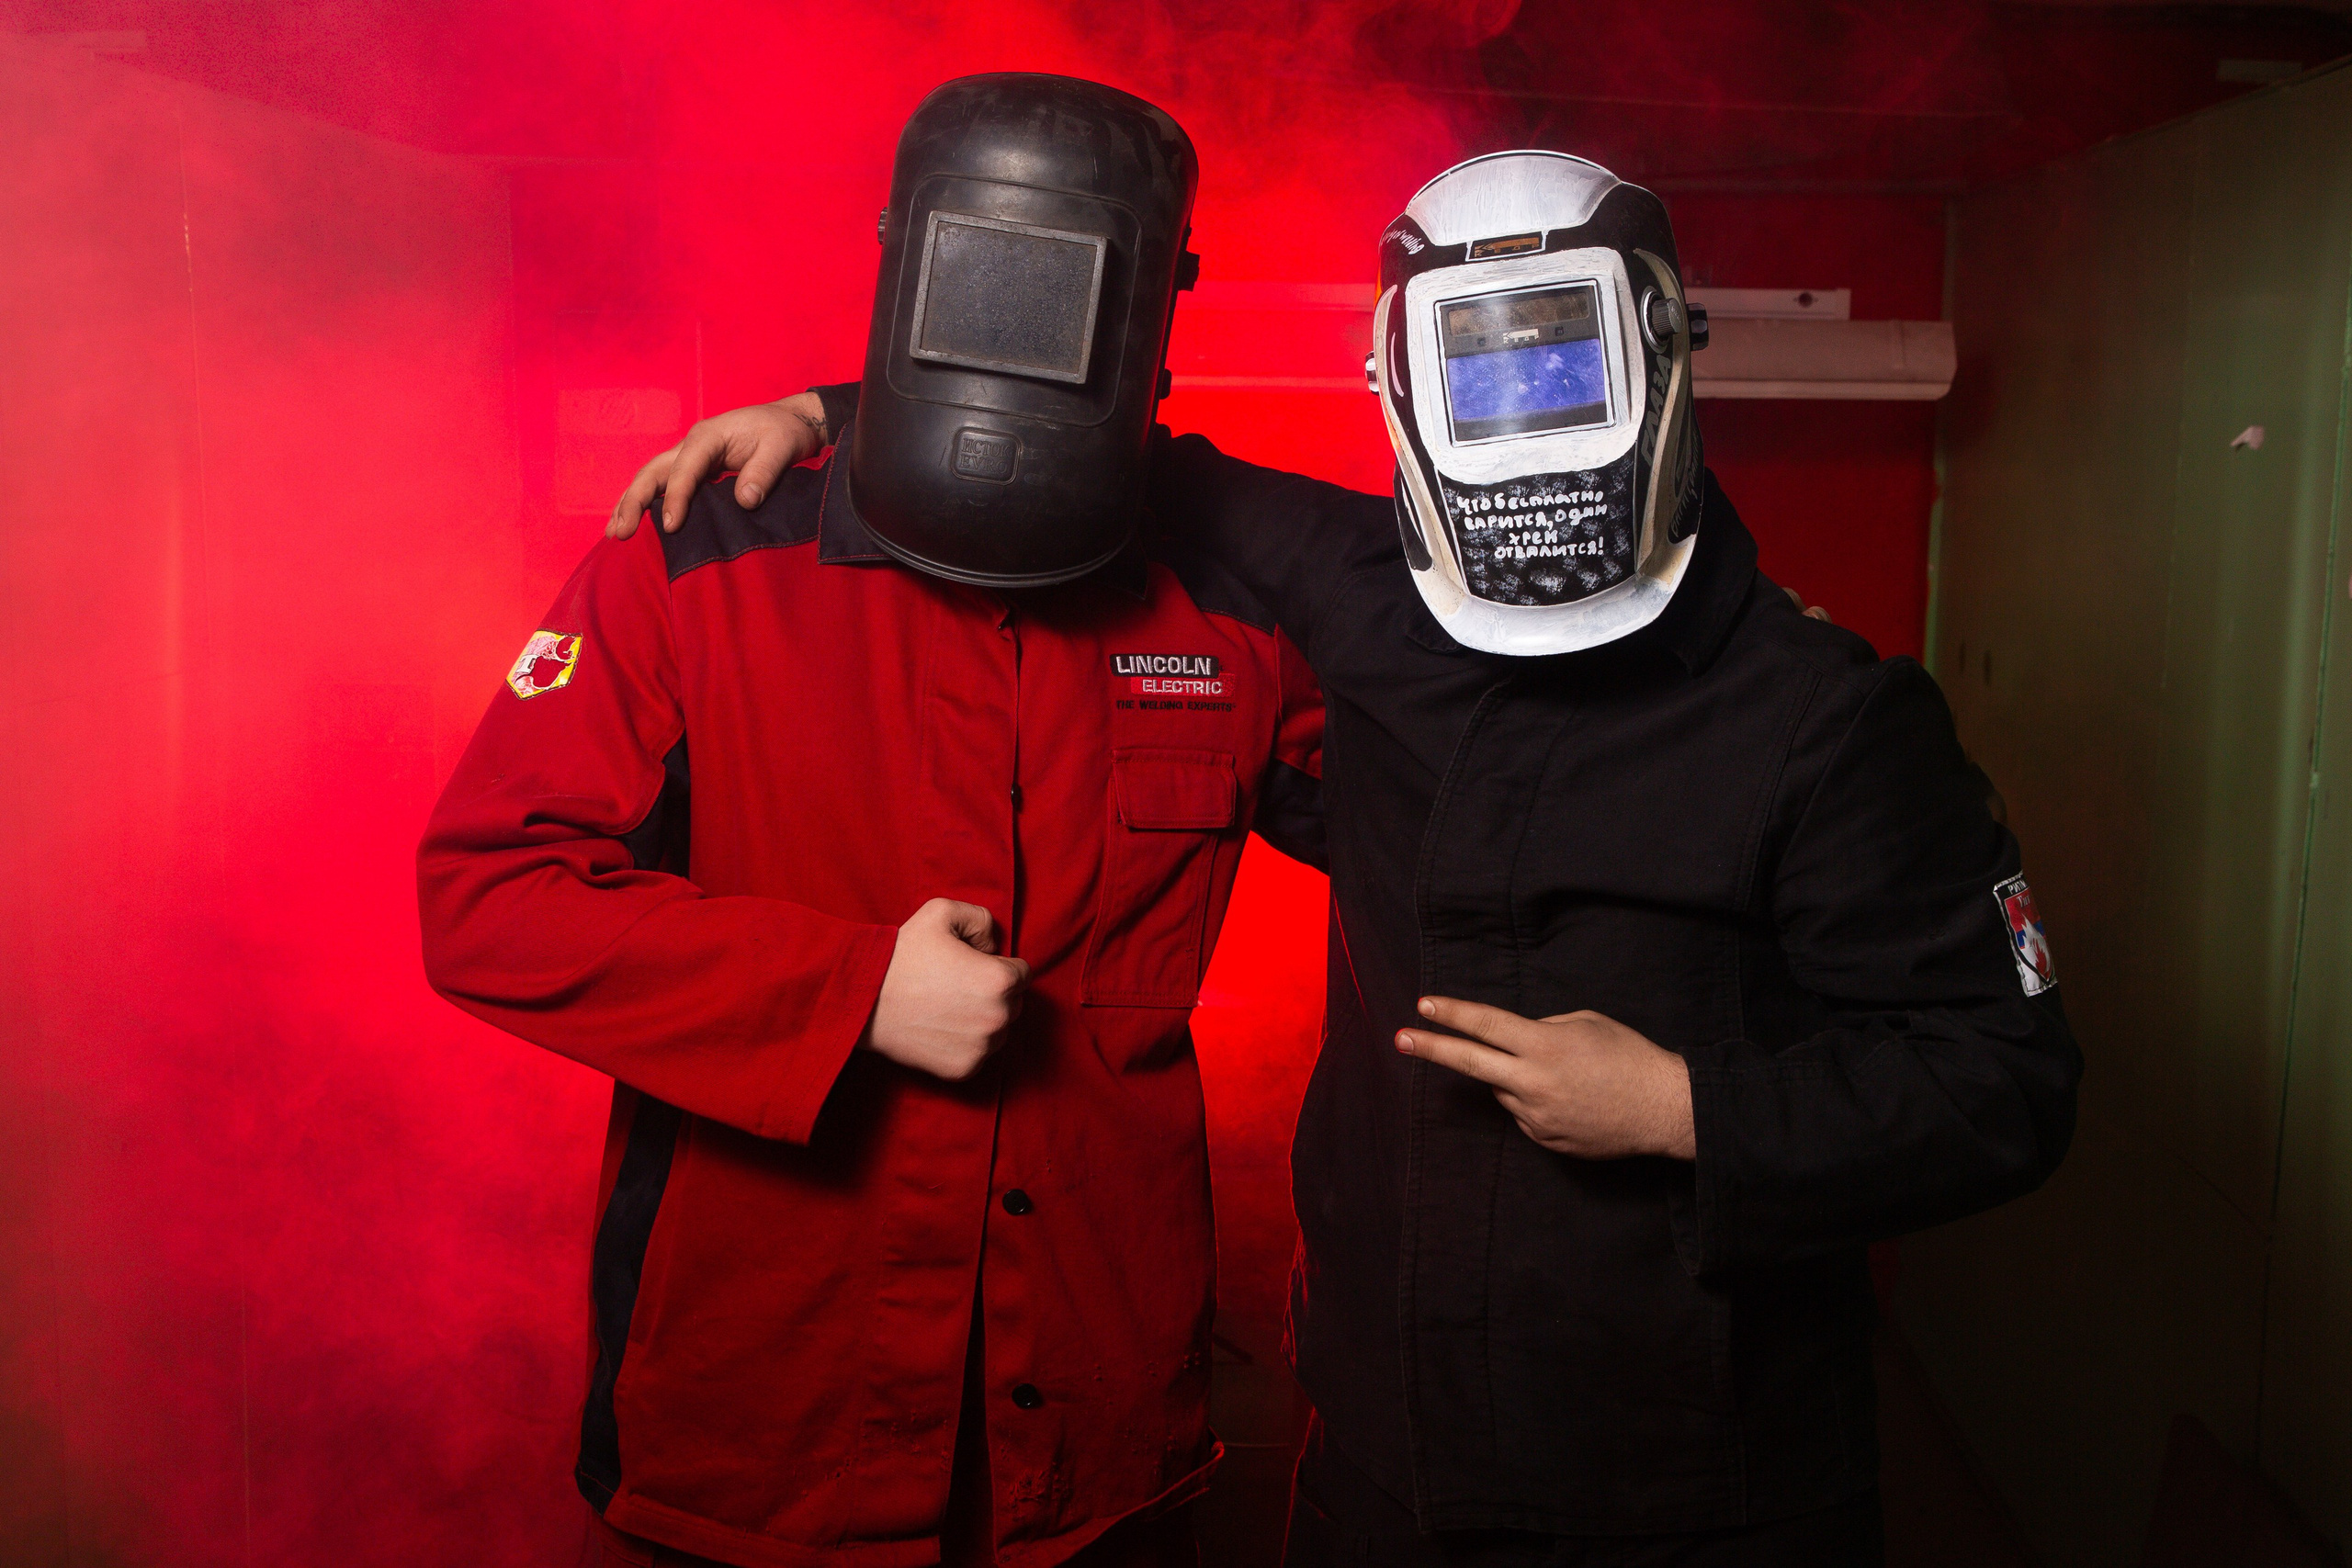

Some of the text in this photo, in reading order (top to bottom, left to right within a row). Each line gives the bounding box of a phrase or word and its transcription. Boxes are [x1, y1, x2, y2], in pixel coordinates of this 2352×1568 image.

[961, 437, 1011, 458] ИСТОК
[959, 454, 1008, 474] EVRO
[1115, 655, 1212, 676] LINCOLN
[1142, 679, 1223, 695] ELECTRIC
[1115, 699, 1135, 710] THE
[1139, 700, 1183, 711] WELDING
